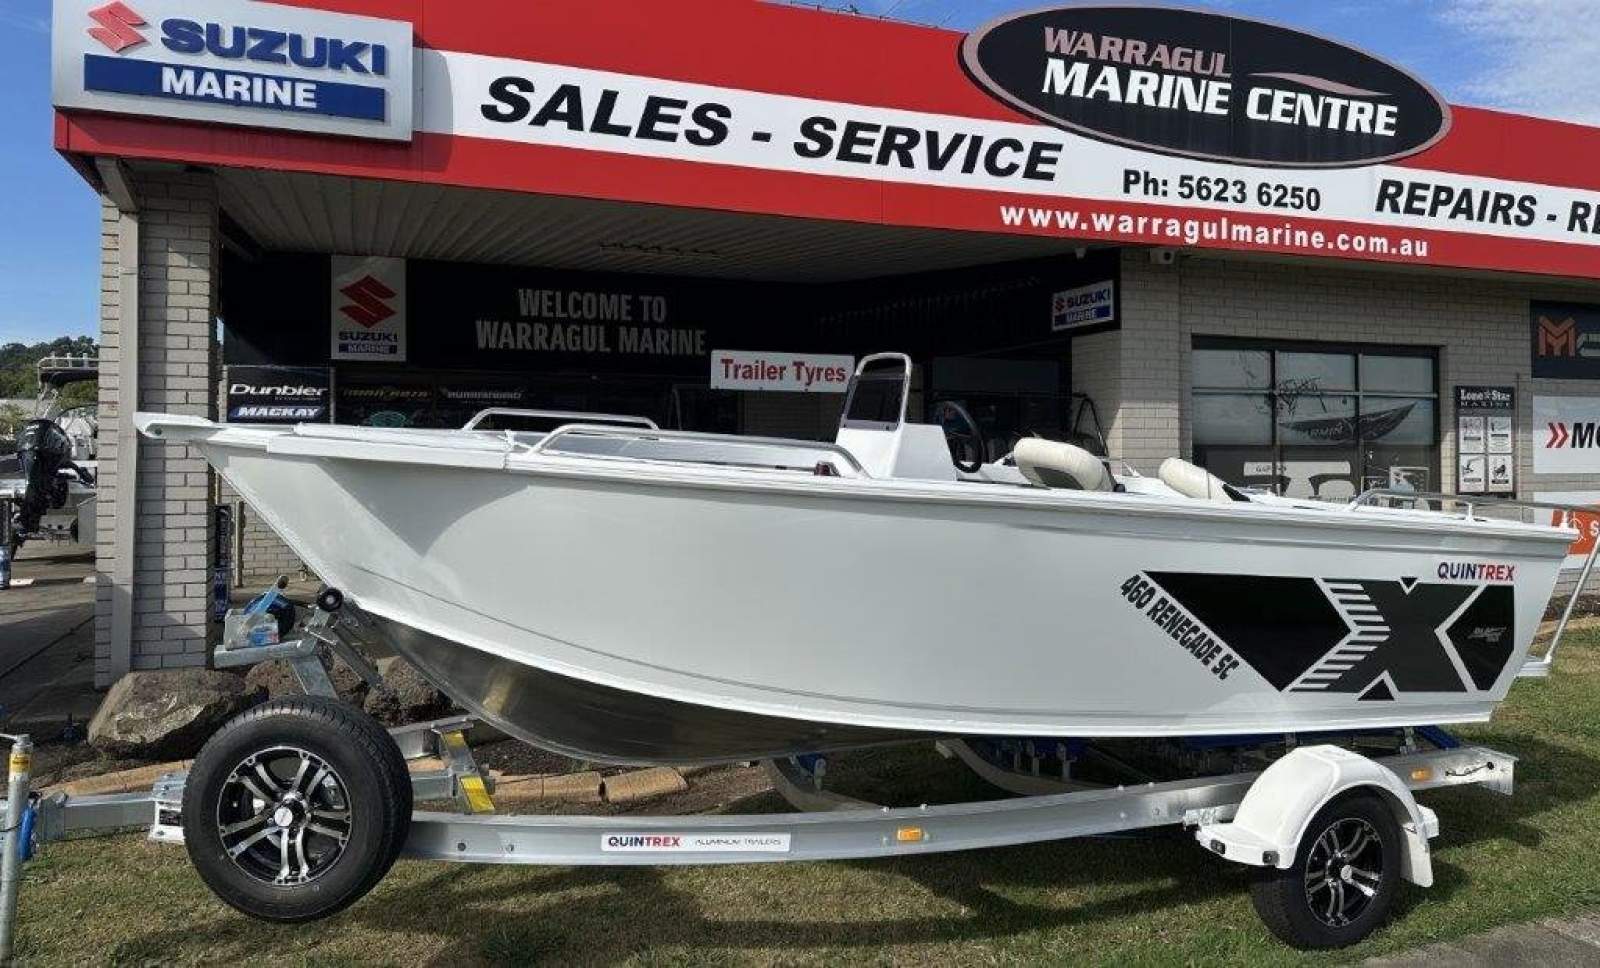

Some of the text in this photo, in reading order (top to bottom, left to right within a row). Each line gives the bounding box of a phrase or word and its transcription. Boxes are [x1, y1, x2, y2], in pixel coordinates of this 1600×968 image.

[160, 17, 386, 76] SUZUKI
[1043, 26, 1232, 77] WARRAGUL
[161, 65, 318, 108] MARINE
[1042, 58, 1398, 137] MARINE CENTRE
[480, 76, 732, 147] SALES
[793, 116, 1064, 182] SERVICE
[1122, 169, 1322, 212] Ph: 5623 6250
[1375, 179, 1537, 228] REPAIRS
[1000, 205, 1429, 258] www.warragulmarine.com.au
[518, 288, 668, 324] WELCOME TO
[1067, 288, 1110, 308] SUZUKI
[339, 331, 398, 342] SUZUKI
[475, 320, 707, 356] WARRAGUL MARINE
[720, 358, 847, 387] Trailer Tyres
[238, 407, 320, 417] MACKAY
[1460, 389, 1484, 401] Lone
[1437, 562, 1515, 582] QUINTREX
[1119, 573, 1240, 680] 460 RENEGADE SC
[608, 836, 681, 847] QUINTREX
